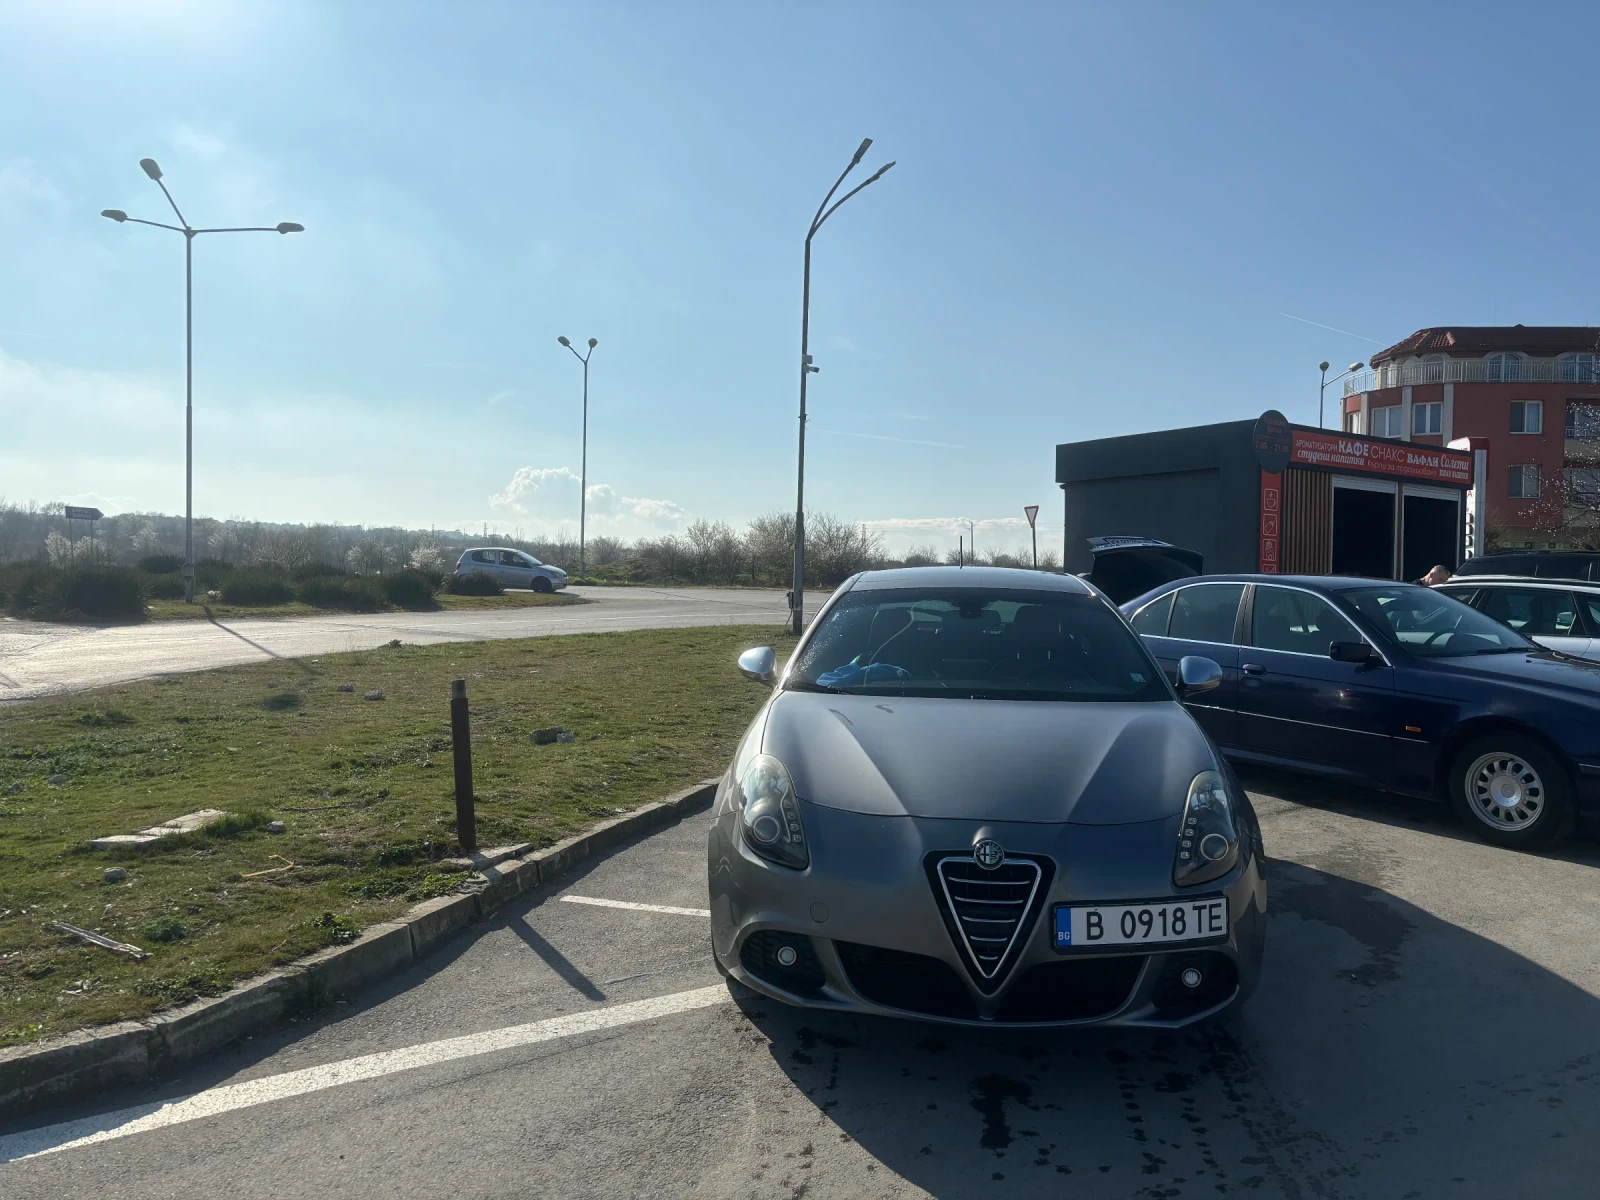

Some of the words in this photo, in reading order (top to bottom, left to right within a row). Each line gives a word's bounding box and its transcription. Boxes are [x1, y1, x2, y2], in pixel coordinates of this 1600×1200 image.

[1297, 449, 1330, 463] студени
[1330, 454, 1365, 466] напитки
[1338, 440, 1369, 457] КАФЕ
[1370, 445, 1405, 462] СНАКС
[1407, 453, 1439, 467] ВАФЛИ
[1120, 906, 1187, 939] 0918
[1058, 931, 1070, 941] BG
